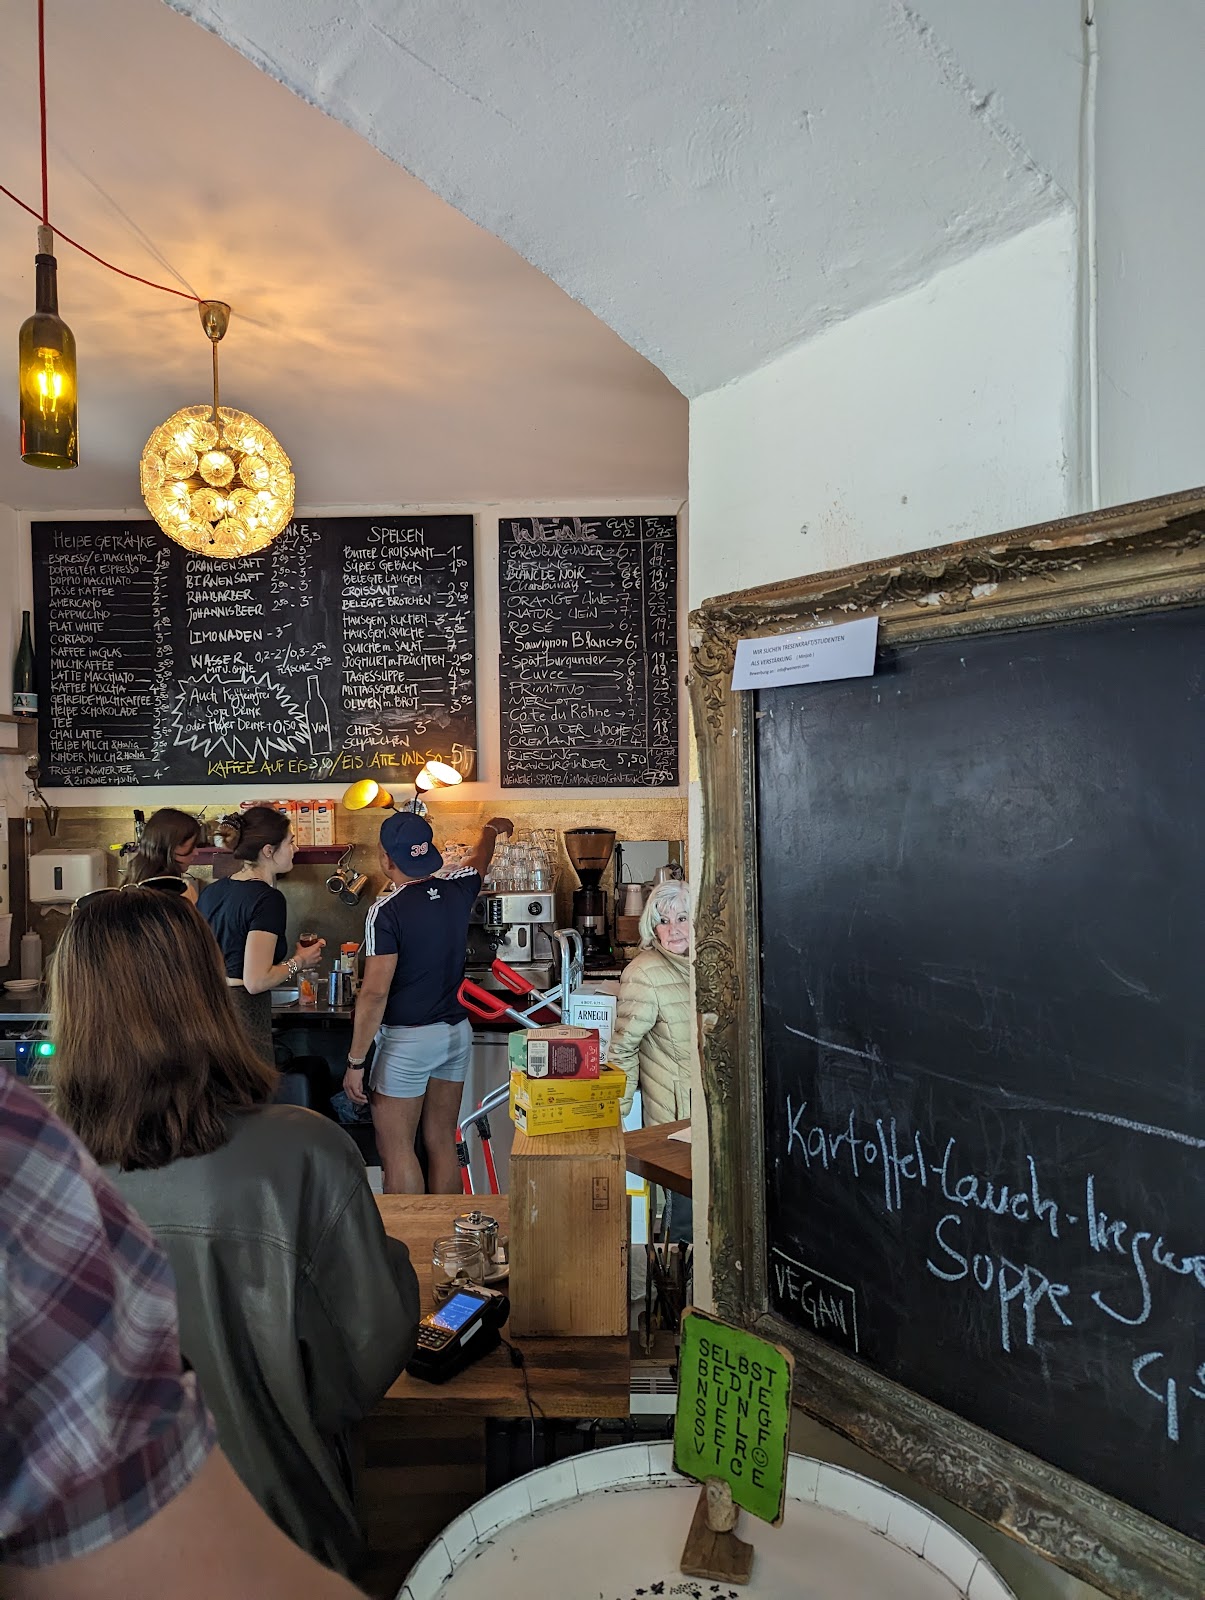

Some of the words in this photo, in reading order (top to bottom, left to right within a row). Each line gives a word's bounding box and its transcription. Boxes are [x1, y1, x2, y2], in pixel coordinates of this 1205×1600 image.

[606, 518, 635, 528] GLAS
[367, 526, 424, 545] SPEISEN
[343, 545, 378, 559] BUTTER
[381, 546, 435, 560] CROISSANT
[49, 566, 96, 575] DOPPELTER
[100, 565, 139, 574] ESPRESSO
[186, 558, 265, 573] ORANGENSAFT
[83, 576, 131, 586] MACCHIATO
[186, 573, 265, 588] BIRNENSAFT
[343, 574, 383, 585] BELEGTE
[386, 574, 422, 586] LAUGEN
[49, 586, 75, 596] TASSE
[78, 586, 115, 596] KAFFEE
[342, 585, 398, 598] CROISSANT
[49, 598, 101, 610] AMERICANO
[342, 598, 385, 610] BELEGTE
[50, 610, 110, 620] CAPPUCCINO
[186, 605, 264, 627] JOHANNISBEER
[391, 614, 428, 627] KUCHEN
[48, 622, 72, 632] FLAT
[75, 623, 104, 633] WHITE
[389, 627, 425, 641] QUICHE
[50, 634, 93, 644] CORTADO
[190, 629, 263, 644] LIMONADEN
[343, 641, 382, 655] QUICHE
[395, 640, 422, 652] SALAT
[515, 636, 568, 655] Sauvignon
[572, 632, 612, 649] Blanc
[763, 646, 781, 654] SUCHEN
[782, 635, 845, 651] TRESENKRAFT/STUDENTEN
[51, 647, 86, 657] KAFFEE
[51, 659, 114, 671] MILCHKAFFEE
[191, 652, 245, 668] WASSER
[342, 655, 388, 669] JOGHURT
[511, 655, 607, 670] Spätburgunder
[761, 655, 792, 665] VERSTÄRKUNG
[51, 671, 81, 680] LATTE
[85, 672, 134, 682] MACCHIATO
[342, 670, 405, 686] TAGESSUPPE
[51, 682, 87, 693] KAFFEE
[342, 684, 418, 698] MITTAGSGERICHT
[509, 682, 584, 697] PRIMITIVO
[190, 686, 218, 706] Auch
[344, 696, 382, 710] OLIVEN
[395, 696, 419, 709] BROT
[81, 707, 138, 717] SCHOKOLADE
[551, 710, 566, 720] du
[52, 718, 72, 728] TEE
[50, 730, 72, 740] CHAI
[76, 730, 103, 738] LATTE
[346, 724, 383, 737] CHIPS
[82, 740, 109, 750] MILCH
[51, 753, 87, 762] KINDER
[89, 753, 116, 763] MILCH
[402, 751, 425, 766] UND
[617, 753, 646, 767] 5,50
[208, 760, 257, 778] KAFFEE
[260, 761, 284, 775] AUF
[578, 1010, 608, 1021] ARNEGUI
[773, 1263, 848, 1336] VEGAN
[699, 1338, 777, 1387] SELBST
